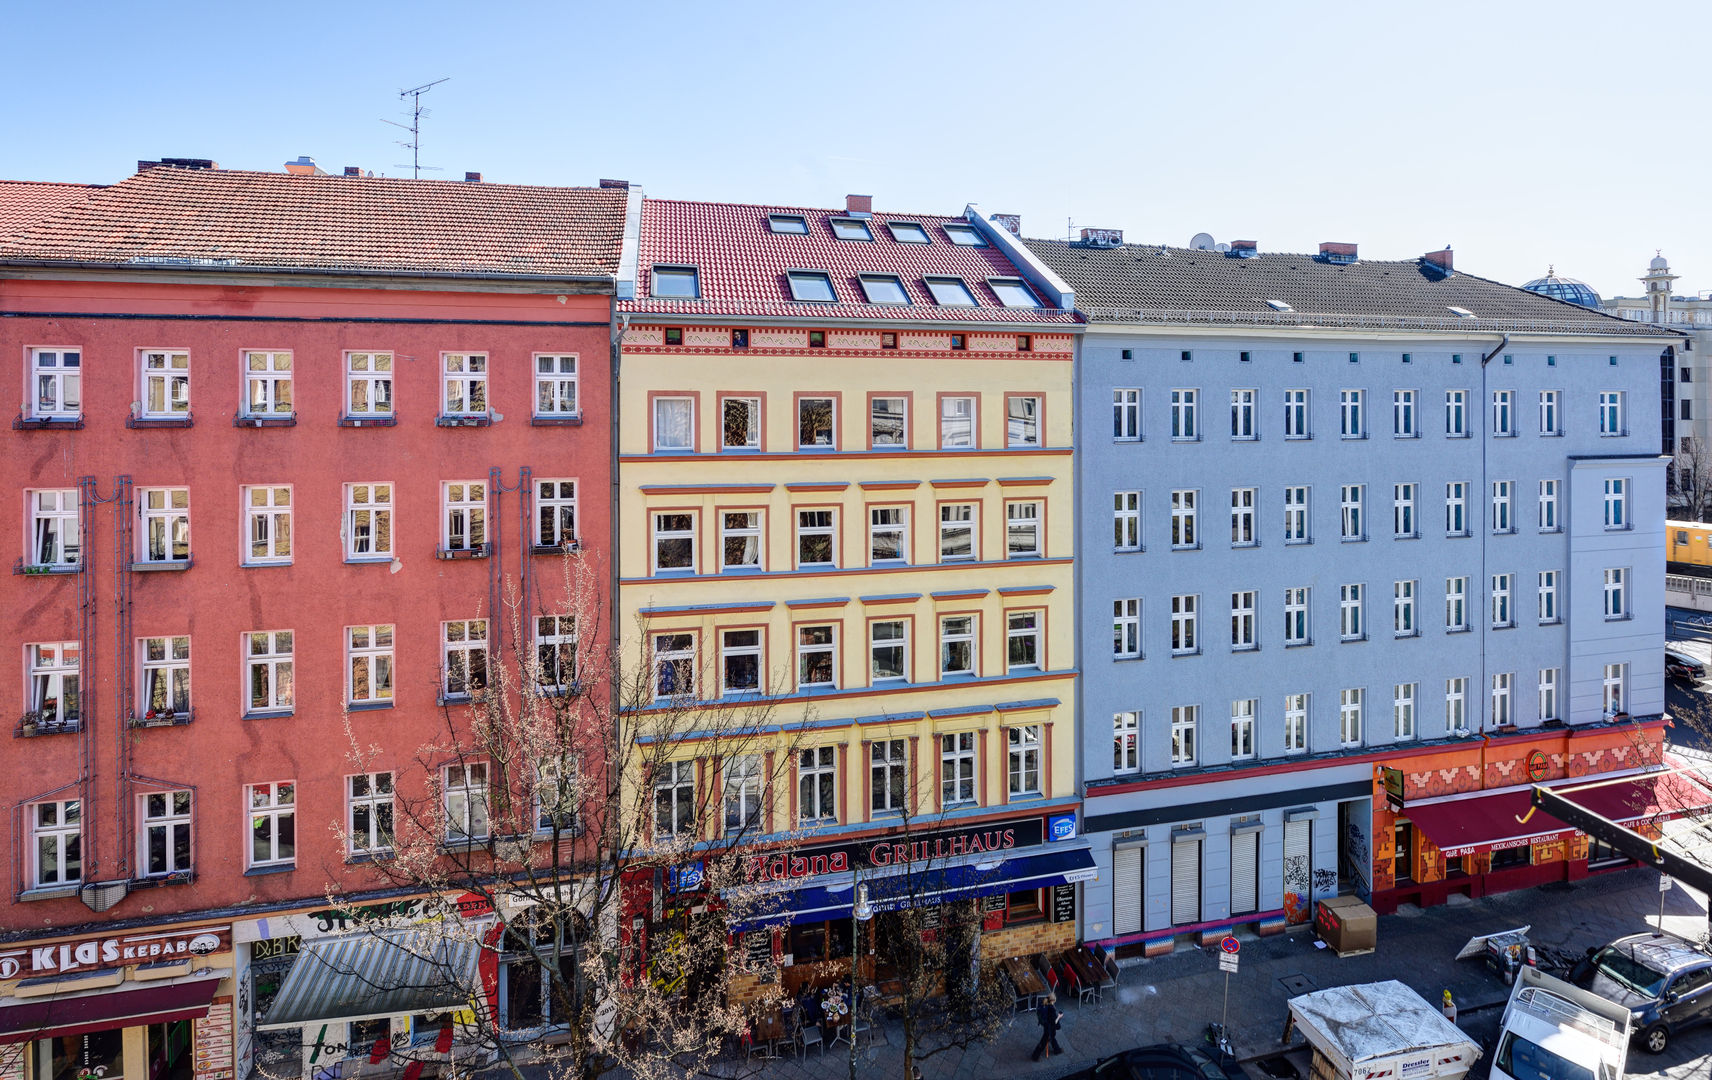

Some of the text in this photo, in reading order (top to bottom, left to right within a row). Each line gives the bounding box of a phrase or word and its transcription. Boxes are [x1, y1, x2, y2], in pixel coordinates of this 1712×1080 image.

[1054, 823, 1073, 834] EFES
[1490, 834, 1559, 851] MEXIKANISCHES RESTAURANT
[748, 828, 1016, 884] Adana GRILLHAUS
[1446, 847, 1475, 858] QUE PASA
[123, 940, 189, 960] KEBAB
[600, 1005, 615, 1016] 2011
[1402, 1059, 1430, 1069] Dressler
